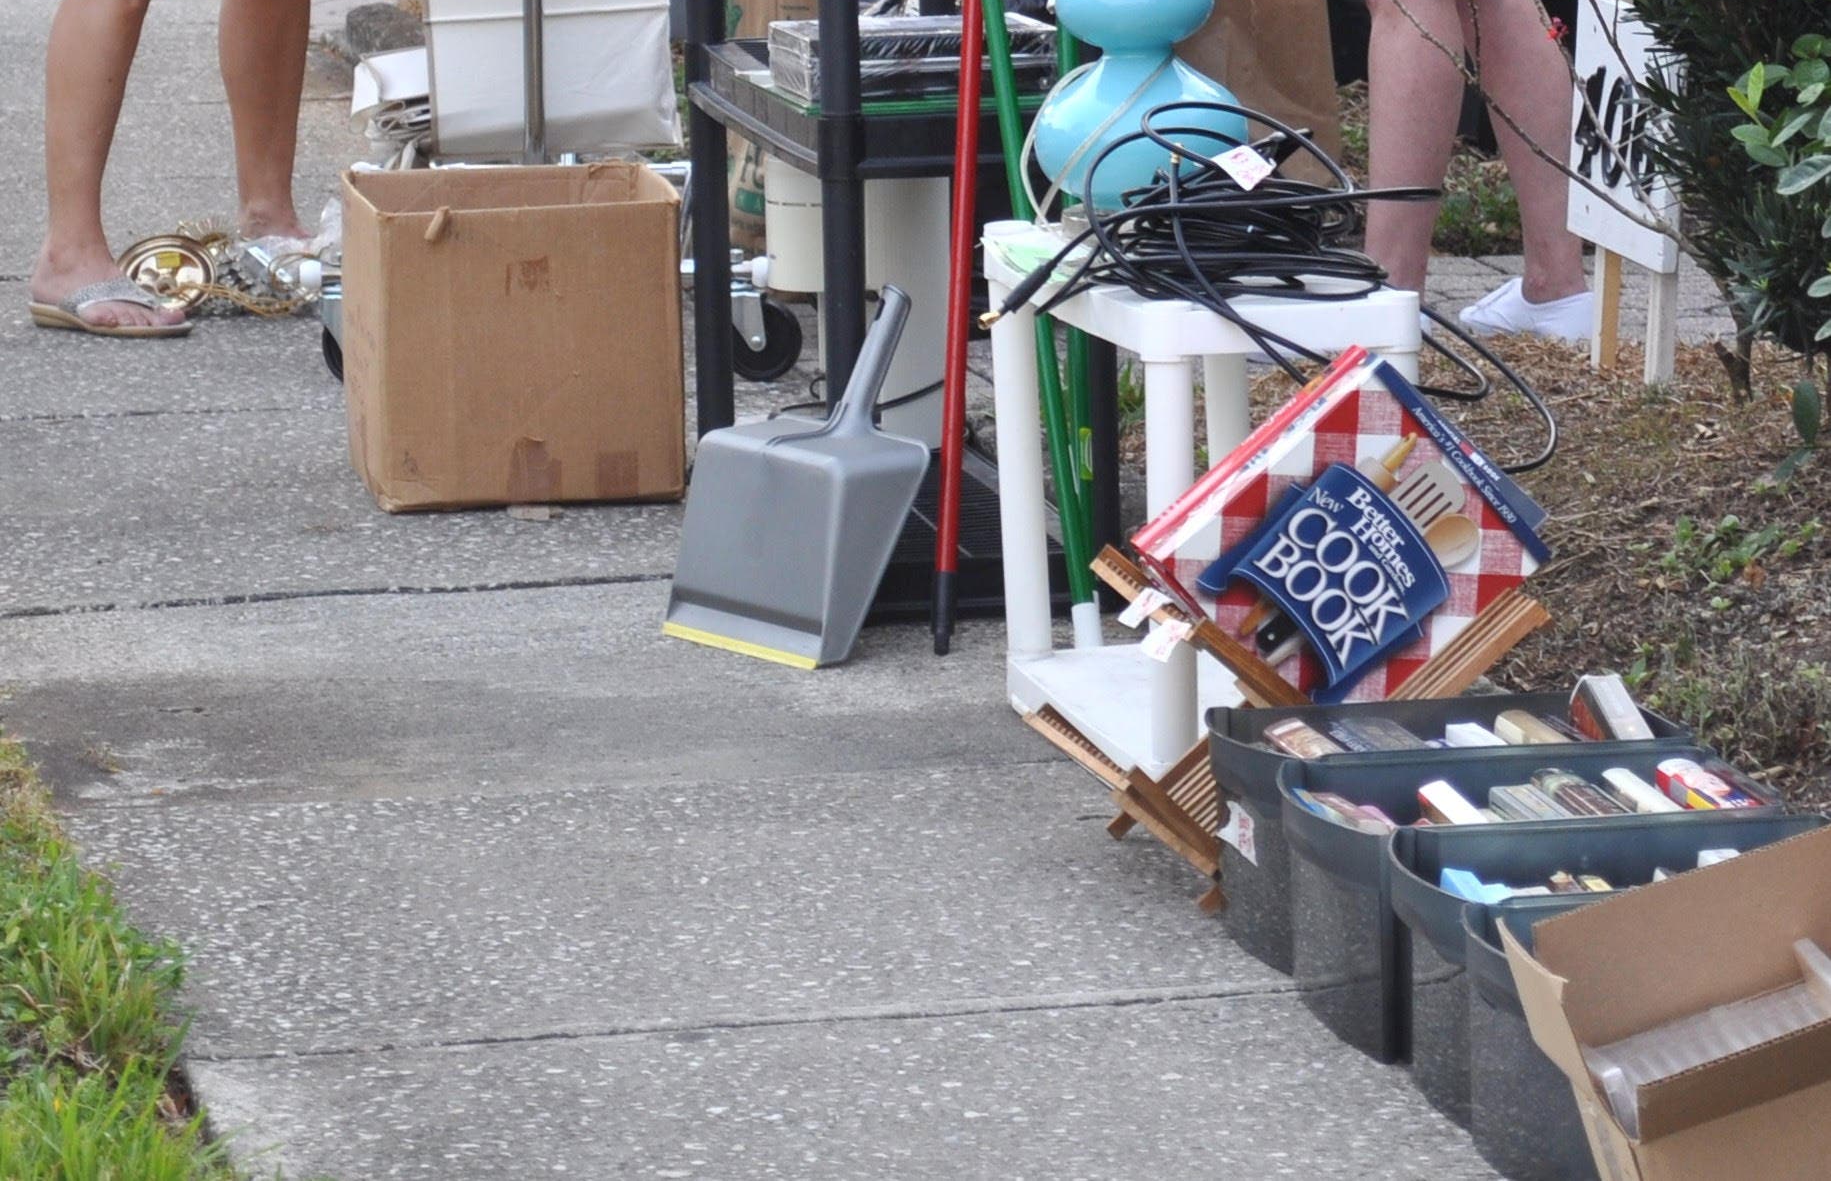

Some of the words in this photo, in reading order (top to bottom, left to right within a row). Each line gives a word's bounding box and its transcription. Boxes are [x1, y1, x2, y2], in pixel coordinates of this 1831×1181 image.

[1307, 486, 1345, 513] New
[1412, 407, 1445, 444] America's
[1451, 450, 1485, 488] Cookbook
[1481, 485, 1501, 506] Since
[1497, 503, 1517, 524] 1930
[1345, 485, 1405, 547] Better
[1349, 515, 1416, 588] Homes
[1367, 544, 1385, 560] and
[1253, 532, 1377, 669] BOOK
[1288, 507, 1409, 645] COOK
